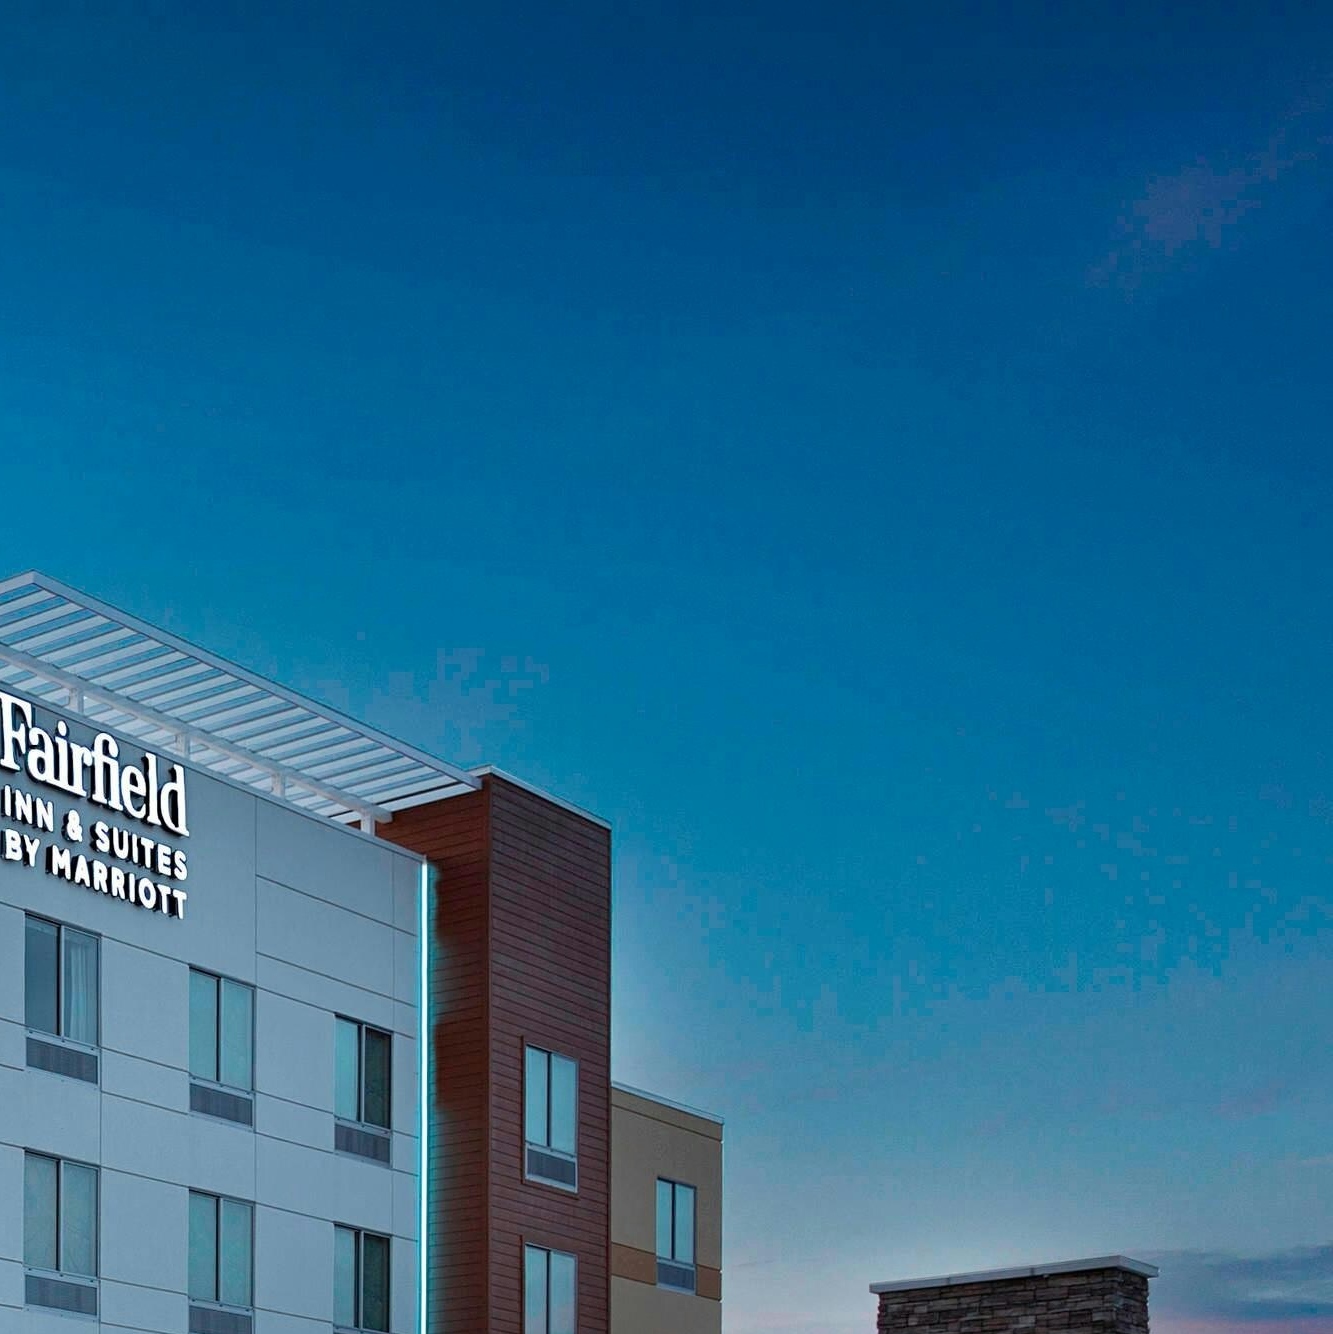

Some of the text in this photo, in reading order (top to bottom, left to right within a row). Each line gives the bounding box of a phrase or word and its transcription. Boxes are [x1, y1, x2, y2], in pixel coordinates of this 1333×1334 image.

[3, 785, 188, 881] INN & SUITES
[3, 828, 188, 919] BY MARRIOTT
